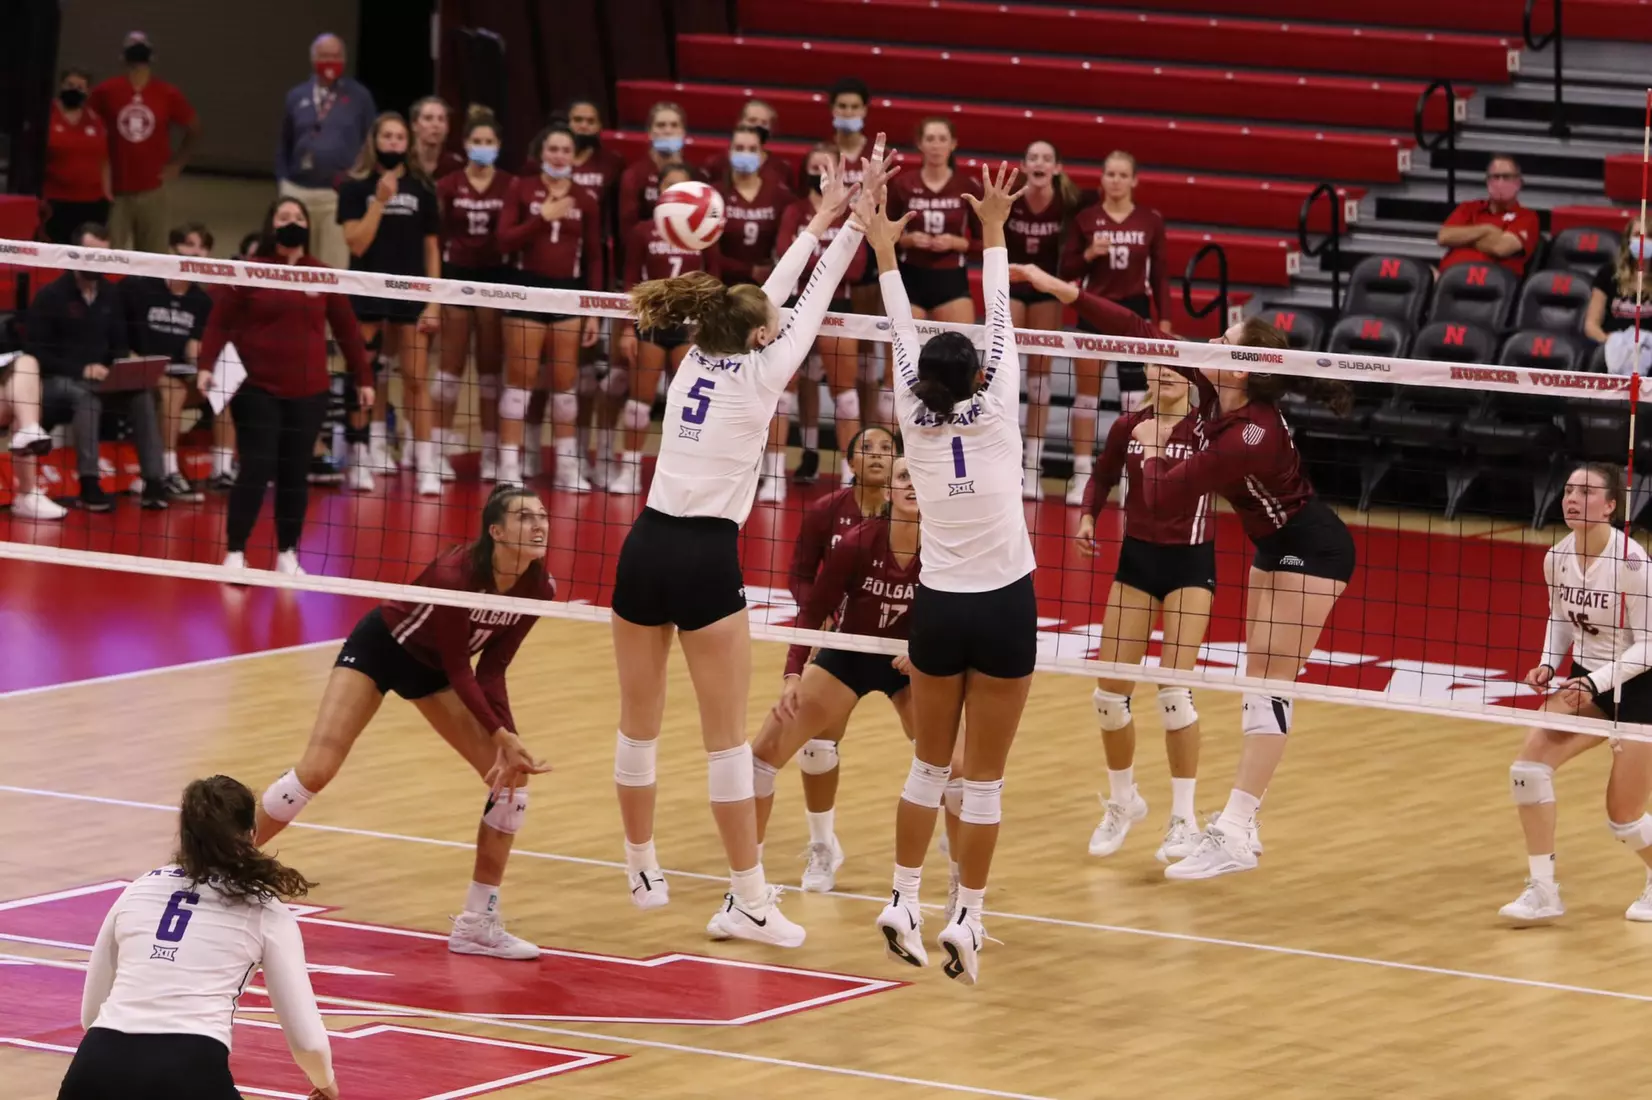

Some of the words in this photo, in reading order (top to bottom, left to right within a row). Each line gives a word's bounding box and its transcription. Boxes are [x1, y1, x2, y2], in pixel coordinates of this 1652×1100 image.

[923, 210, 945, 234] 19
[743, 221, 759, 246] 9
[1577, 233, 1599, 253] N
[84, 253, 130, 264] SUBARU
[668, 256, 683, 278] 7
[1108, 245, 1129, 270] 13
[1380, 258, 1401, 278] N
[179, 260, 237, 277] HUSKER
[244, 266, 339, 285] VOLLEYBALL
[1466, 266, 1489, 286] N
[480, 288, 528, 300] SUBARU
[1551, 274, 1573, 296] N
[579, 295, 633, 310] HUSKE
[1274, 312, 1296, 332] N
[1360, 319, 1384, 341] N
[1014, 333, 1065, 348] USKER
[1073, 337, 1179, 358] VOLLEYBALL
[1443, 324, 1467, 345] N
[1231, 351, 1284, 364] BEARDMORE
[1531, 337, 1554, 357] N
[1338, 360, 1391, 372] SUBARU
[1450, 366, 1519, 385] HUSKER
[1528, 372, 1642, 391] VOLLEYBAL
[681, 377, 716, 425] 5
[951, 436, 967, 478] 1
[1127, 439, 1194, 459] COATE
[862, 576, 919, 600] COLGA
[878, 602, 908, 629] 17
[156, 890, 200, 942] 6
